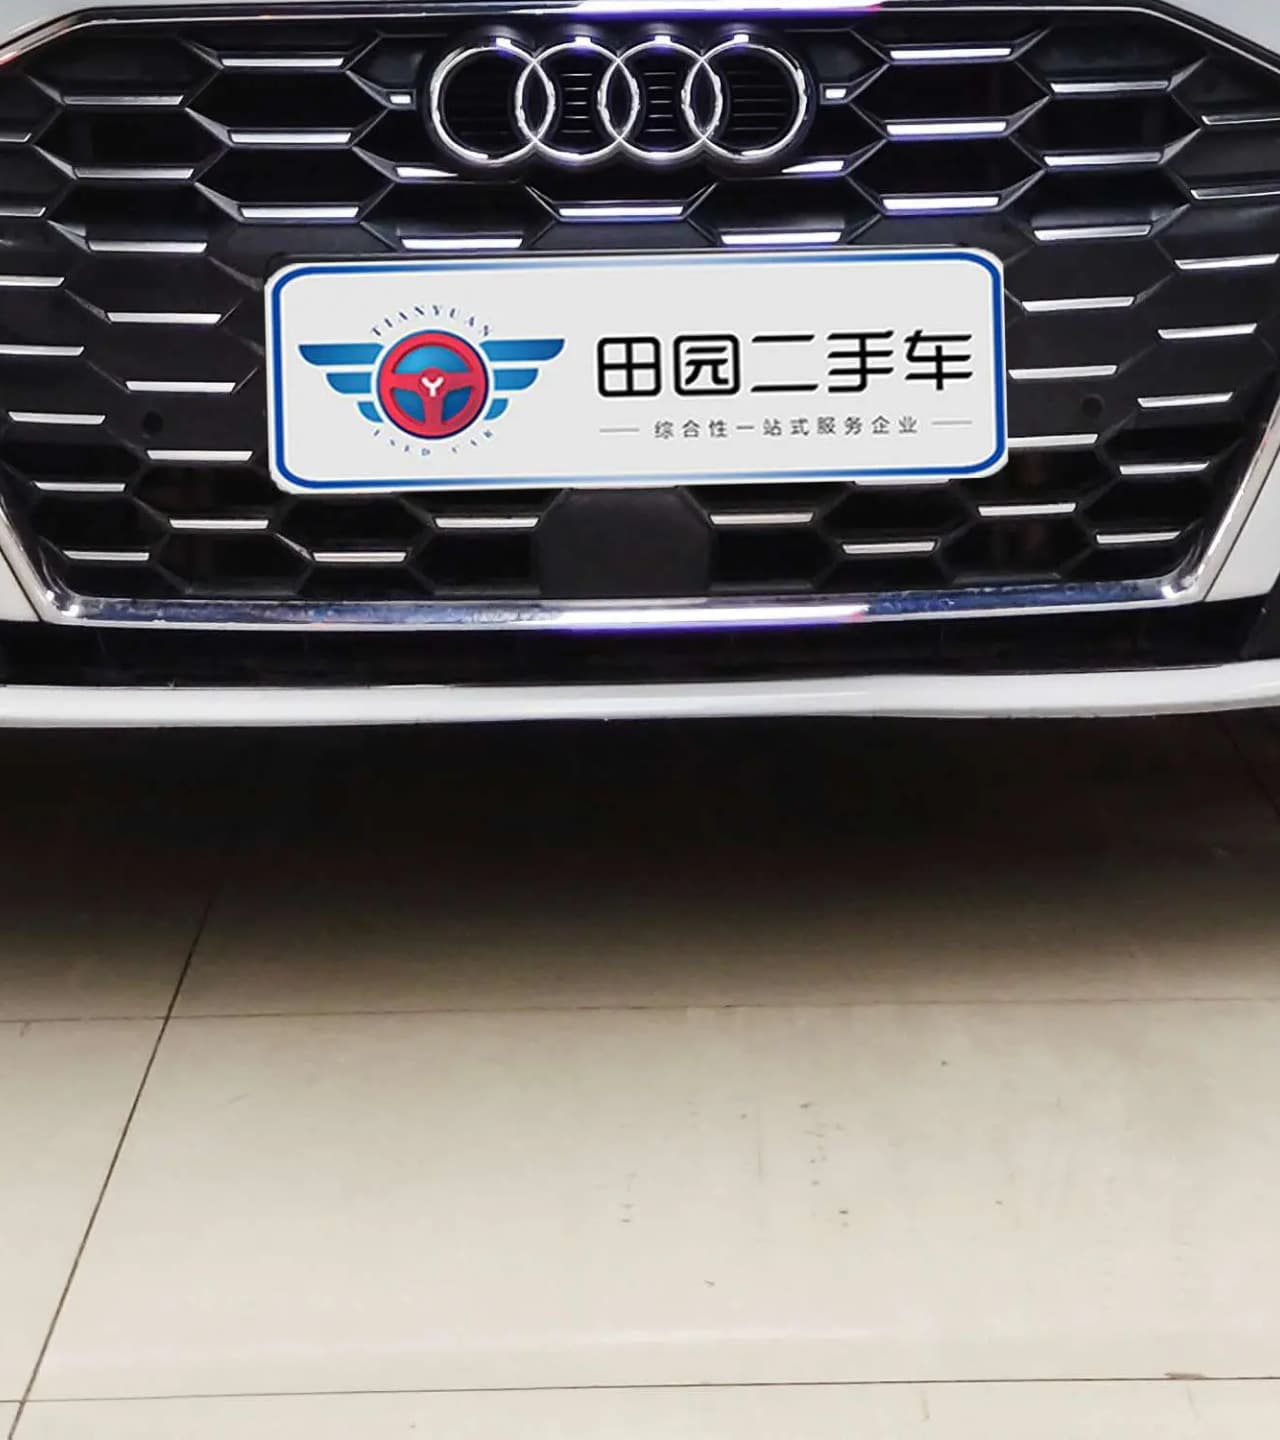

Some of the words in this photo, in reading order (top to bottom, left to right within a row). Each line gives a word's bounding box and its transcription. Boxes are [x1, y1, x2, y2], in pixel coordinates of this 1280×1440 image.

[596, 329, 974, 398] 田园二手车
[652, 415, 919, 440] 综合性一站式服务企业
